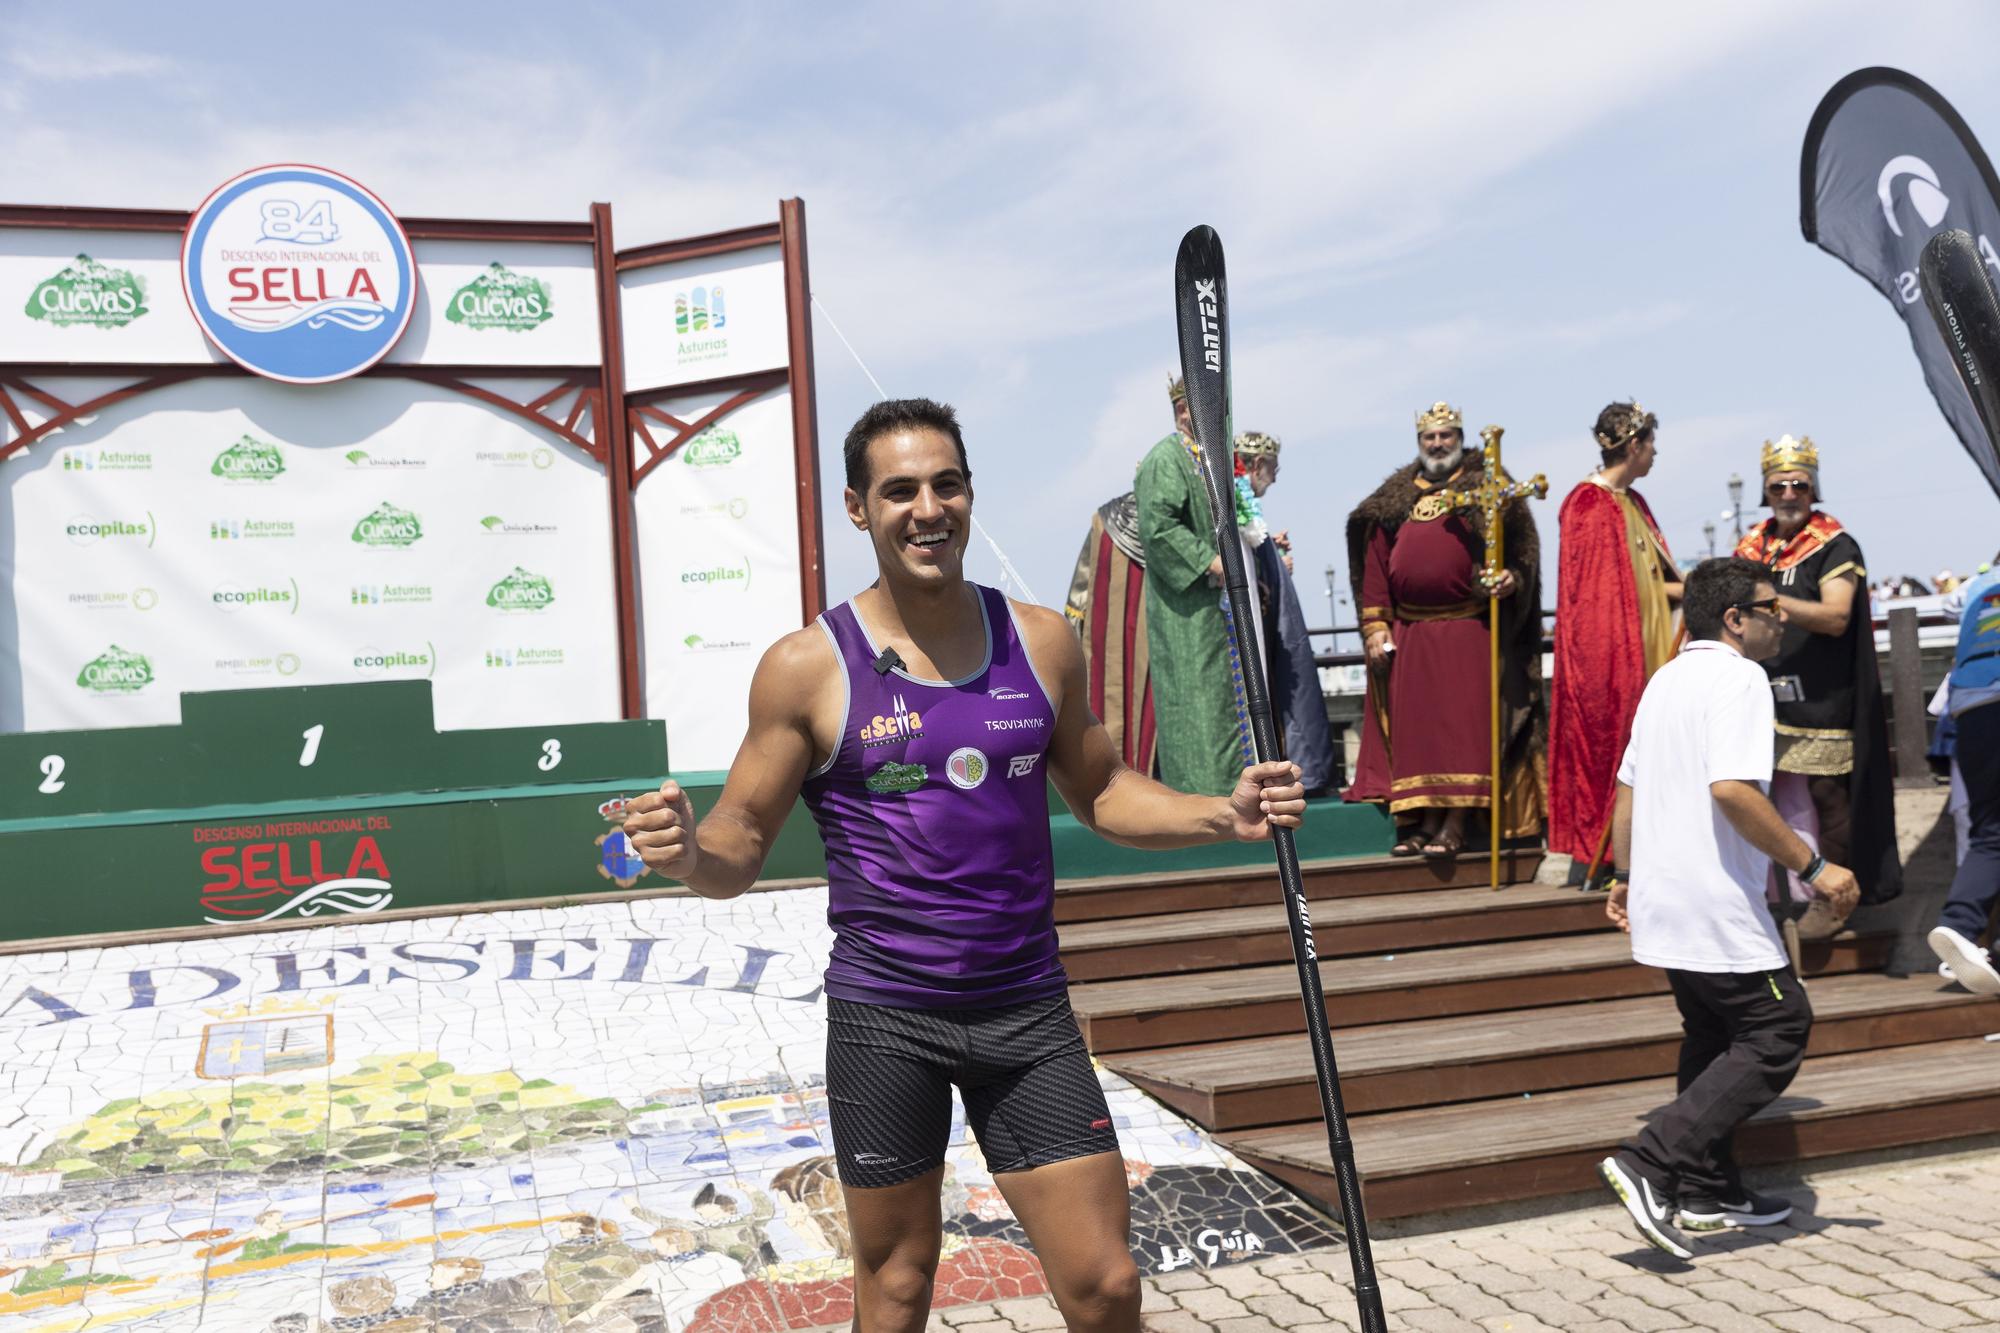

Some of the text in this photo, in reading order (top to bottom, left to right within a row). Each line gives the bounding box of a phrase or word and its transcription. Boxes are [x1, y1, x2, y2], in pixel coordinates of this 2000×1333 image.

[261, 199, 338, 241] 84
[280, 250, 359, 263] INTERNACIONAL
[362, 252, 382, 263] DEL
[228, 268, 382, 303] SELLA
[39, 285, 136, 313] Cuevas
[457, 291, 542, 318] Cuevas
[678, 339, 728, 354] Asturias
[99, 451, 152, 464] Asturias
[66, 520, 148, 538] ecopilas
[244, 519, 295, 531] Asturias
[681, 566, 745, 584] ecopilas
[213, 588, 291, 605] ecopilas
[383, 584, 432, 596] Asturias
[353, 652, 428, 673] ecopilas
[516, 648, 564, 659] Asturias
[299, 724, 325, 767] 1
[538, 738, 563, 771] 3
[38, 754, 66, 794] 2
[193, 816, 392, 843] DESCENSO INTERNACIONAL DEL
[201, 836, 392, 894] SELLA
